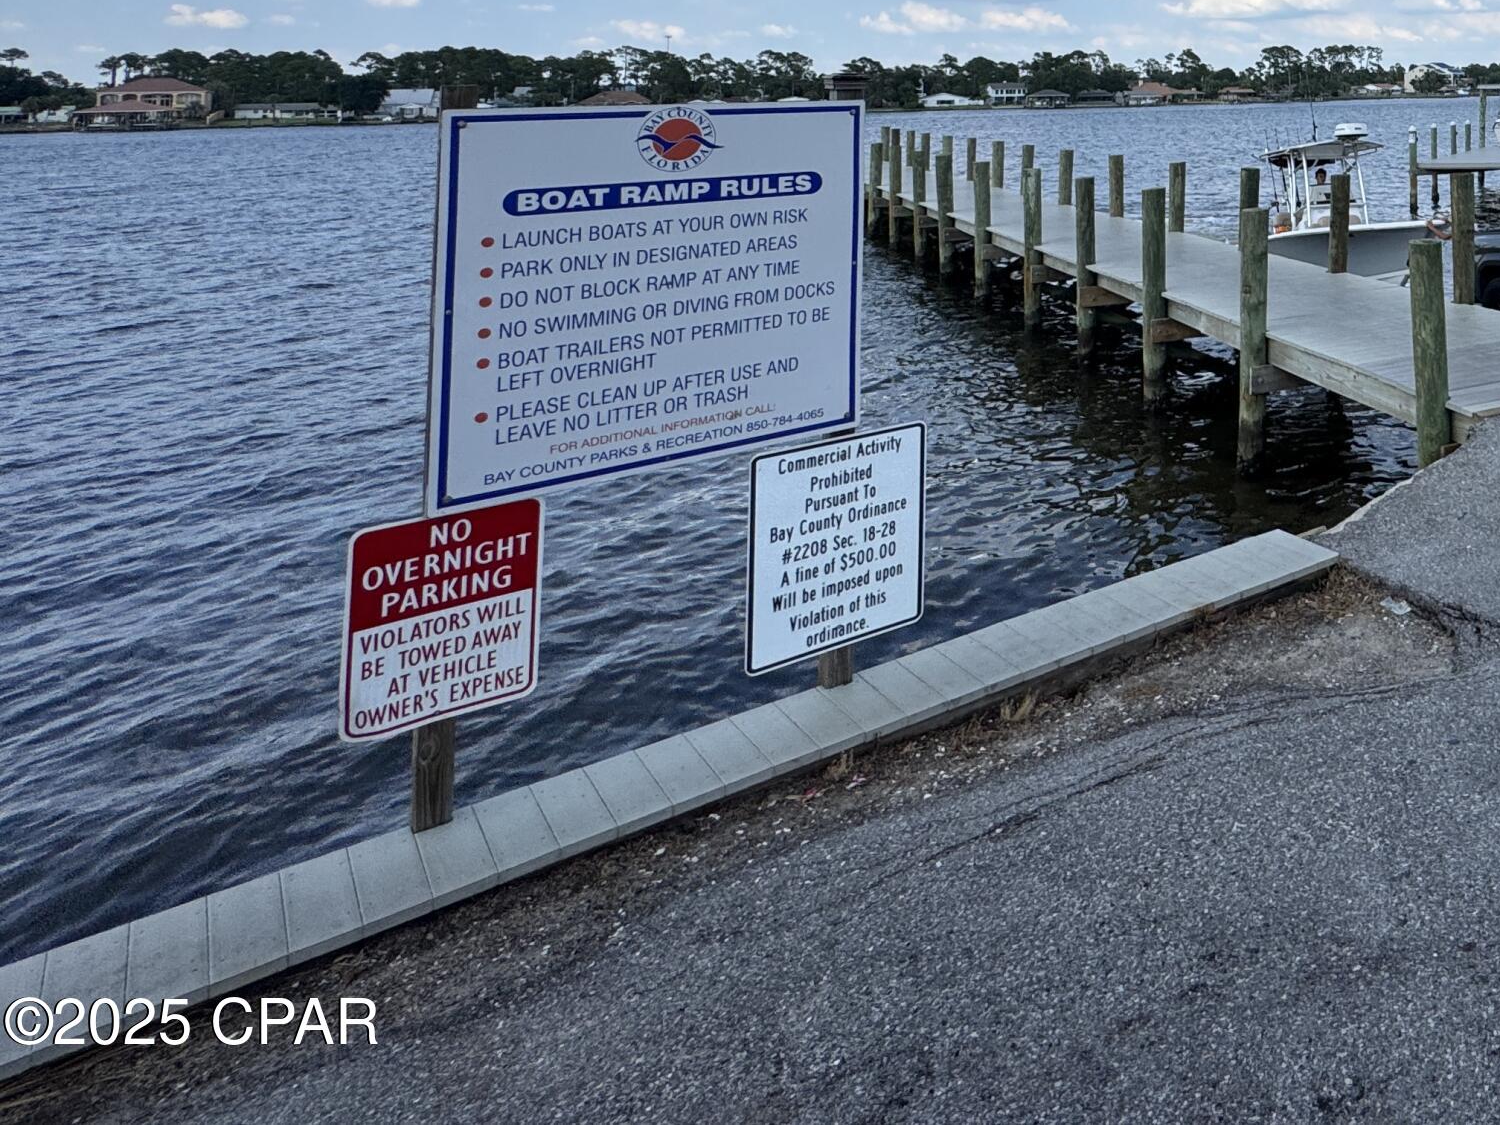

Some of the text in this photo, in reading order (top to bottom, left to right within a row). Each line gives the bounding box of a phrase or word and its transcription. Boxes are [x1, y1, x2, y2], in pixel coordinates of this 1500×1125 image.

[644, 109, 714, 138] BAY COUNTY
[641, 145, 709, 171] FLORIDA
[517, 175, 812, 212] BOAT RAMP RULES
[503, 208, 807, 249] LAUNCH BOATS AT YOUR OWN RISK
[501, 235, 797, 278] PARK ONLY IN DESIGNATED AREAS
[500, 260, 799, 309] DO NOT BLOCK RAMP AT ANY TIME
[499, 282, 835, 339] NO SWIMMING OR DIVING FROM DOCKS
[498, 307, 830, 369] BOAT TRAILERS NOT PERMITTED TO BE
[496, 357, 798, 422] PLEASE CLEAN UP AFTER USE AND
[498, 354, 656, 392] LEFT OVERNIGHT
[495, 386, 748, 445] LEAVE NO LITTER OR TRASH
[550, 442, 577, 454] FOR
[581, 427, 657, 449] ADDITIONAL
[661, 411, 742, 432] INFORMATION
[484, 408, 824, 486] BAY COUNTY PARKS & RECREATION 850-784-4065
[778, 436, 902, 475] Commercial Activity
[805, 483, 876, 514] Pursuant To
[810, 464, 872, 493] Prohibited
[430, 519, 472, 548] NO
[770, 497, 906, 545] Bay County Ordinance
[782, 521, 896, 565] #2208 Sec. 18-28
[362, 533, 532, 591] OVERNIGHT
[780, 541, 896, 587] A fine of $500.00
[381, 566, 512, 617] PARKING
[772, 563, 904, 613] Will be imposed upon
[360, 596, 525, 655] VIOLATORS WILL
[789, 590, 886, 633] Violation of this
[806, 619, 869, 647] ordinance.
[361, 621, 521, 681] BE TOWED AWAY
[387, 651, 496, 699] AT VEHICLE
[355, 667, 524, 730] OWNER'S EXPENSE
